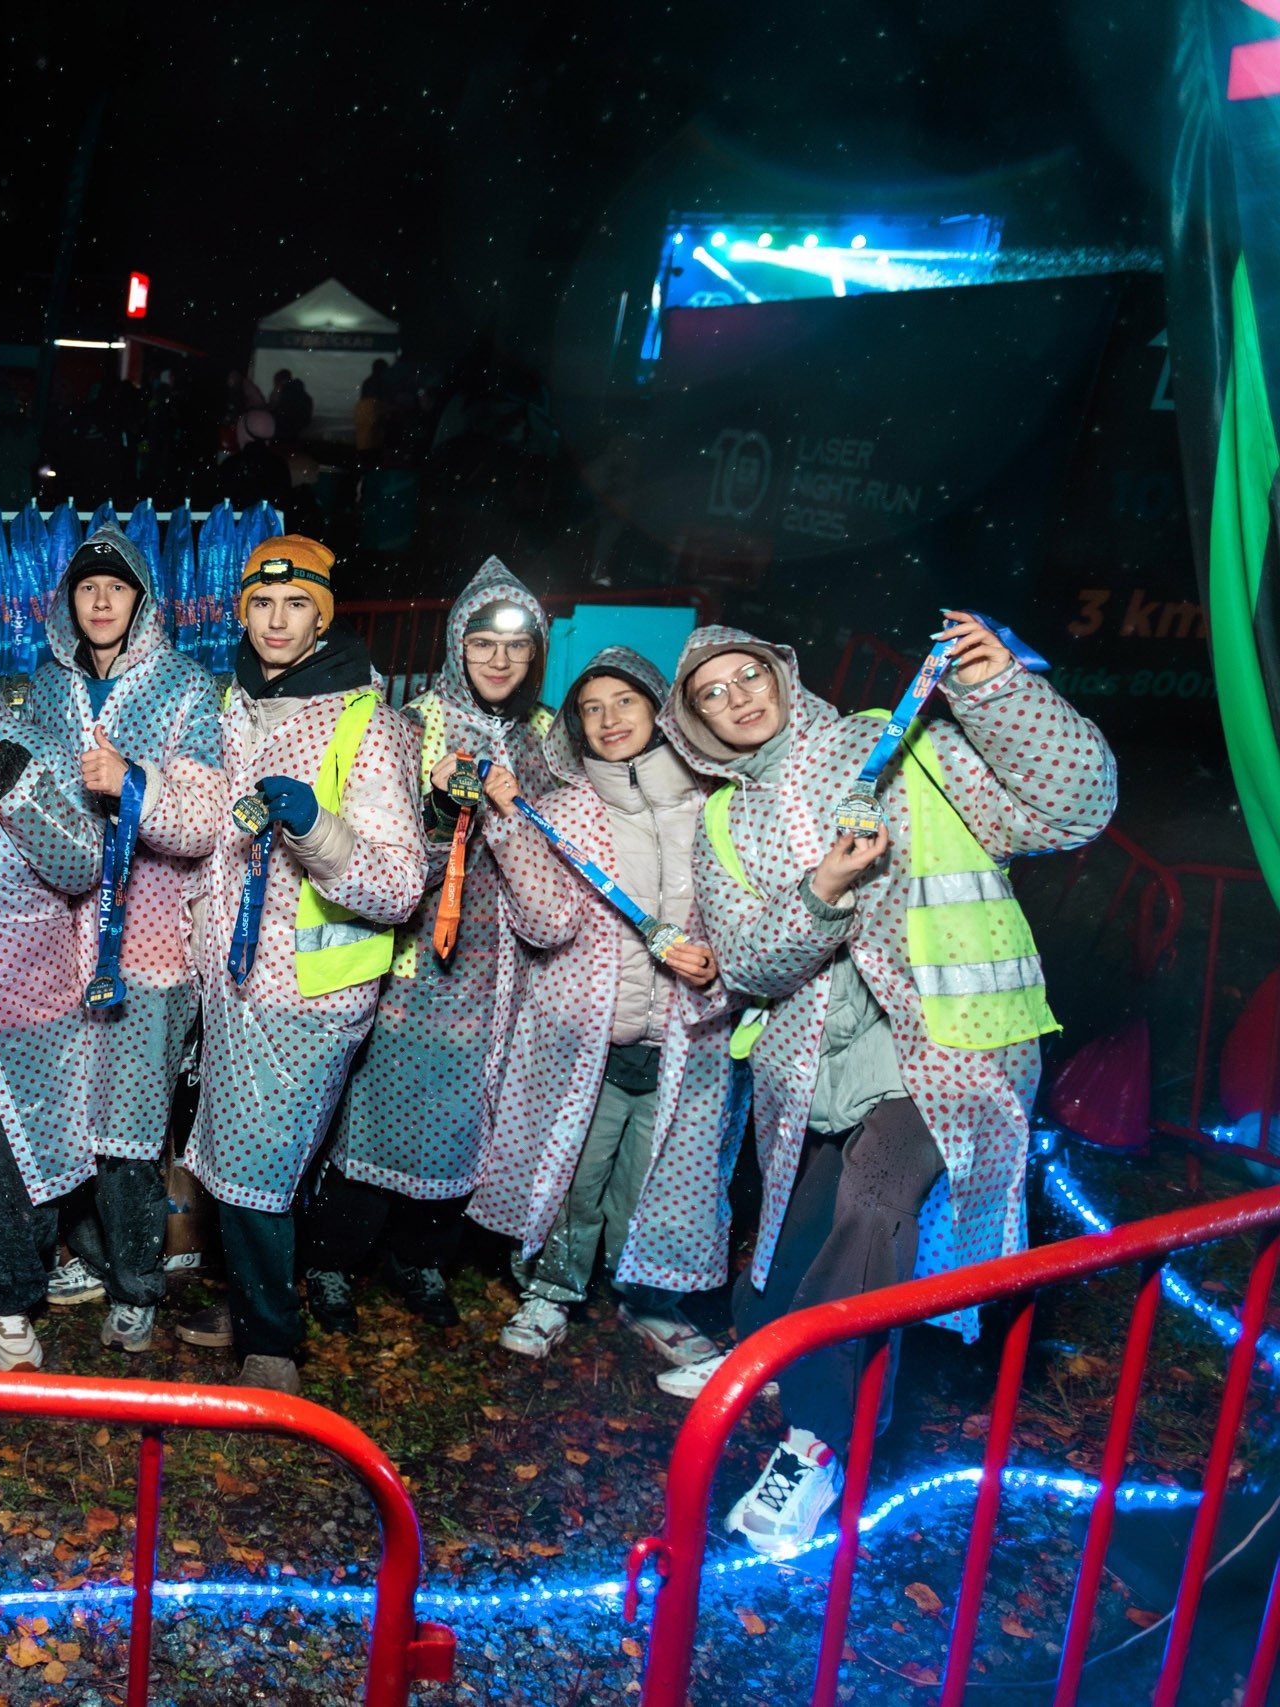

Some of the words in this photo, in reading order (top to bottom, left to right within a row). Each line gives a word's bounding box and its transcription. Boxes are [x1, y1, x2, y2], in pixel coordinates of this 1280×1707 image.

[799, 436, 875, 471] LASER
[863, 480, 923, 516] RUN
[781, 508, 848, 541] 2025
[1066, 588, 1111, 638] 3
[912, 654, 939, 699] 2025
[447, 880, 455, 908] LASER
[457, 812, 467, 846] 2025
[556, 839, 591, 866] 2025
[100, 889, 112, 912] KM
[241, 912, 250, 937] LASER
[251, 843, 262, 877] 2025
